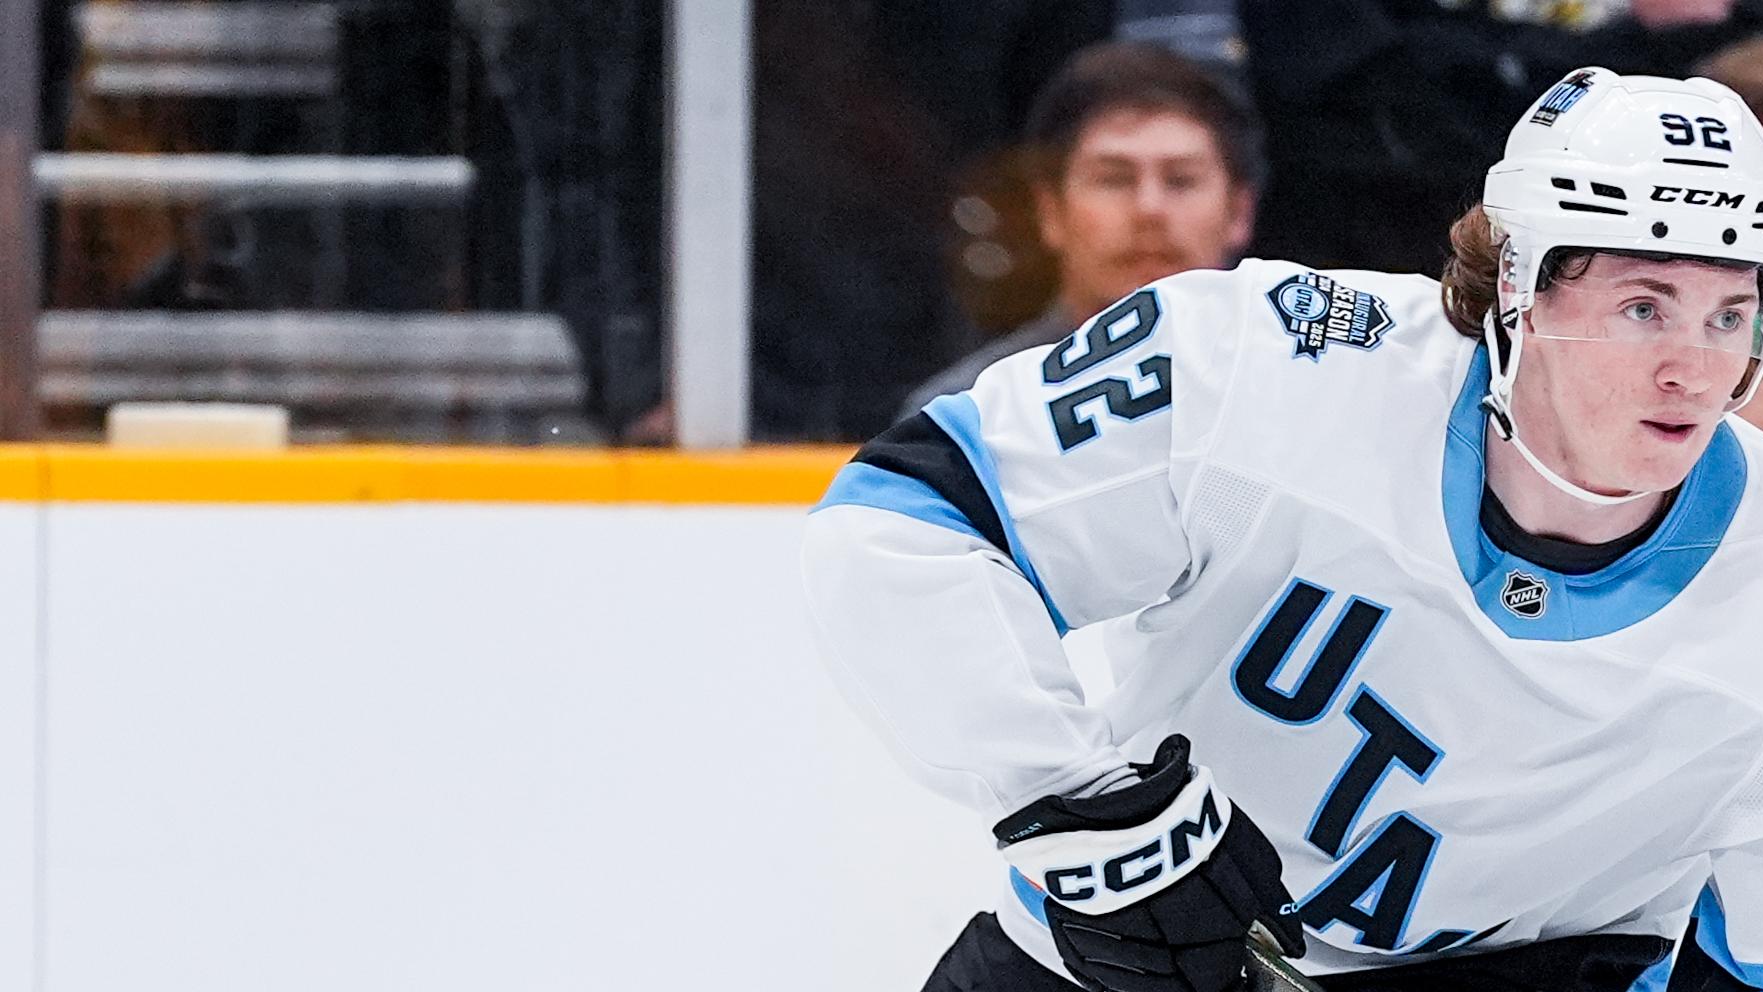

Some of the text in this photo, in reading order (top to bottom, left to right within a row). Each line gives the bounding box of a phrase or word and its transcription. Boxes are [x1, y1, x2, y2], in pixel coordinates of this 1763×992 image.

[1658, 112, 1734, 153] 92
[1650, 184, 1746, 210] CCM
[1294, 288, 1313, 316] UTAH
[1325, 283, 1356, 342] SEASON
[1349, 291, 1372, 342] INAUGURAL
[1308, 322, 1325, 348] 2025
[1041, 286, 1172, 455] 92
[1510, 588, 1540, 604] NHL
[1044, 782, 1222, 902] CCM
